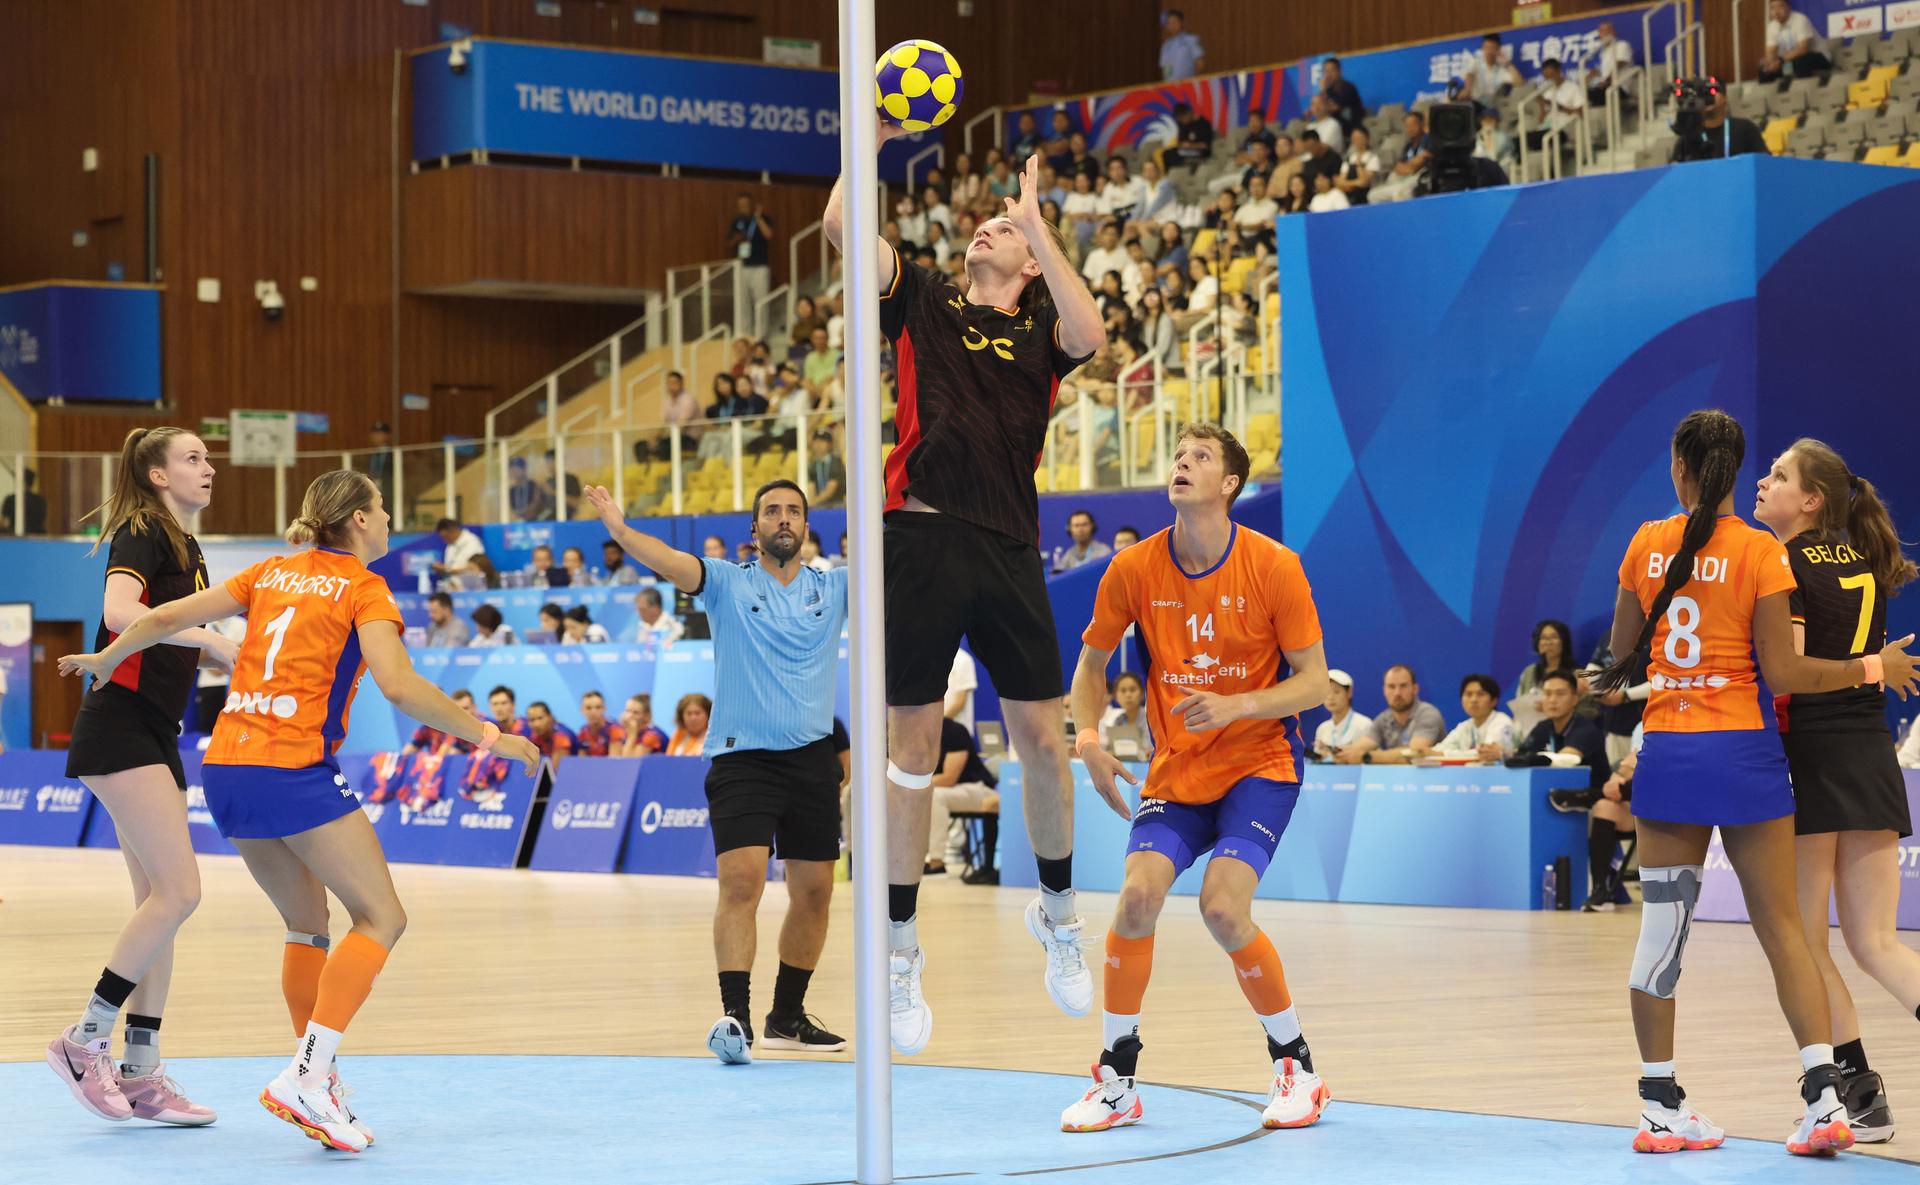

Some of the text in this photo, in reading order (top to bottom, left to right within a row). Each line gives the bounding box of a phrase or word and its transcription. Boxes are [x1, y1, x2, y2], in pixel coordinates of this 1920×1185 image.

[515, 83, 564, 114] THE
[567, 88, 658, 121] WORLD
[661, 96, 746, 128] GAMES
[750, 104, 810, 134] 2025
[254, 568, 350, 602] LOKHORST
[1152, 600, 1177, 608] CRAFT
[1838, 572, 1876, 655] 7
[263, 606, 296, 681] 1
[1186, 613, 1215, 643] 14
[1664, 596, 1702, 669] 8
[1251, 821, 1273, 838] CRAFT
[304, 1033, 316, 1064] CRAFT
